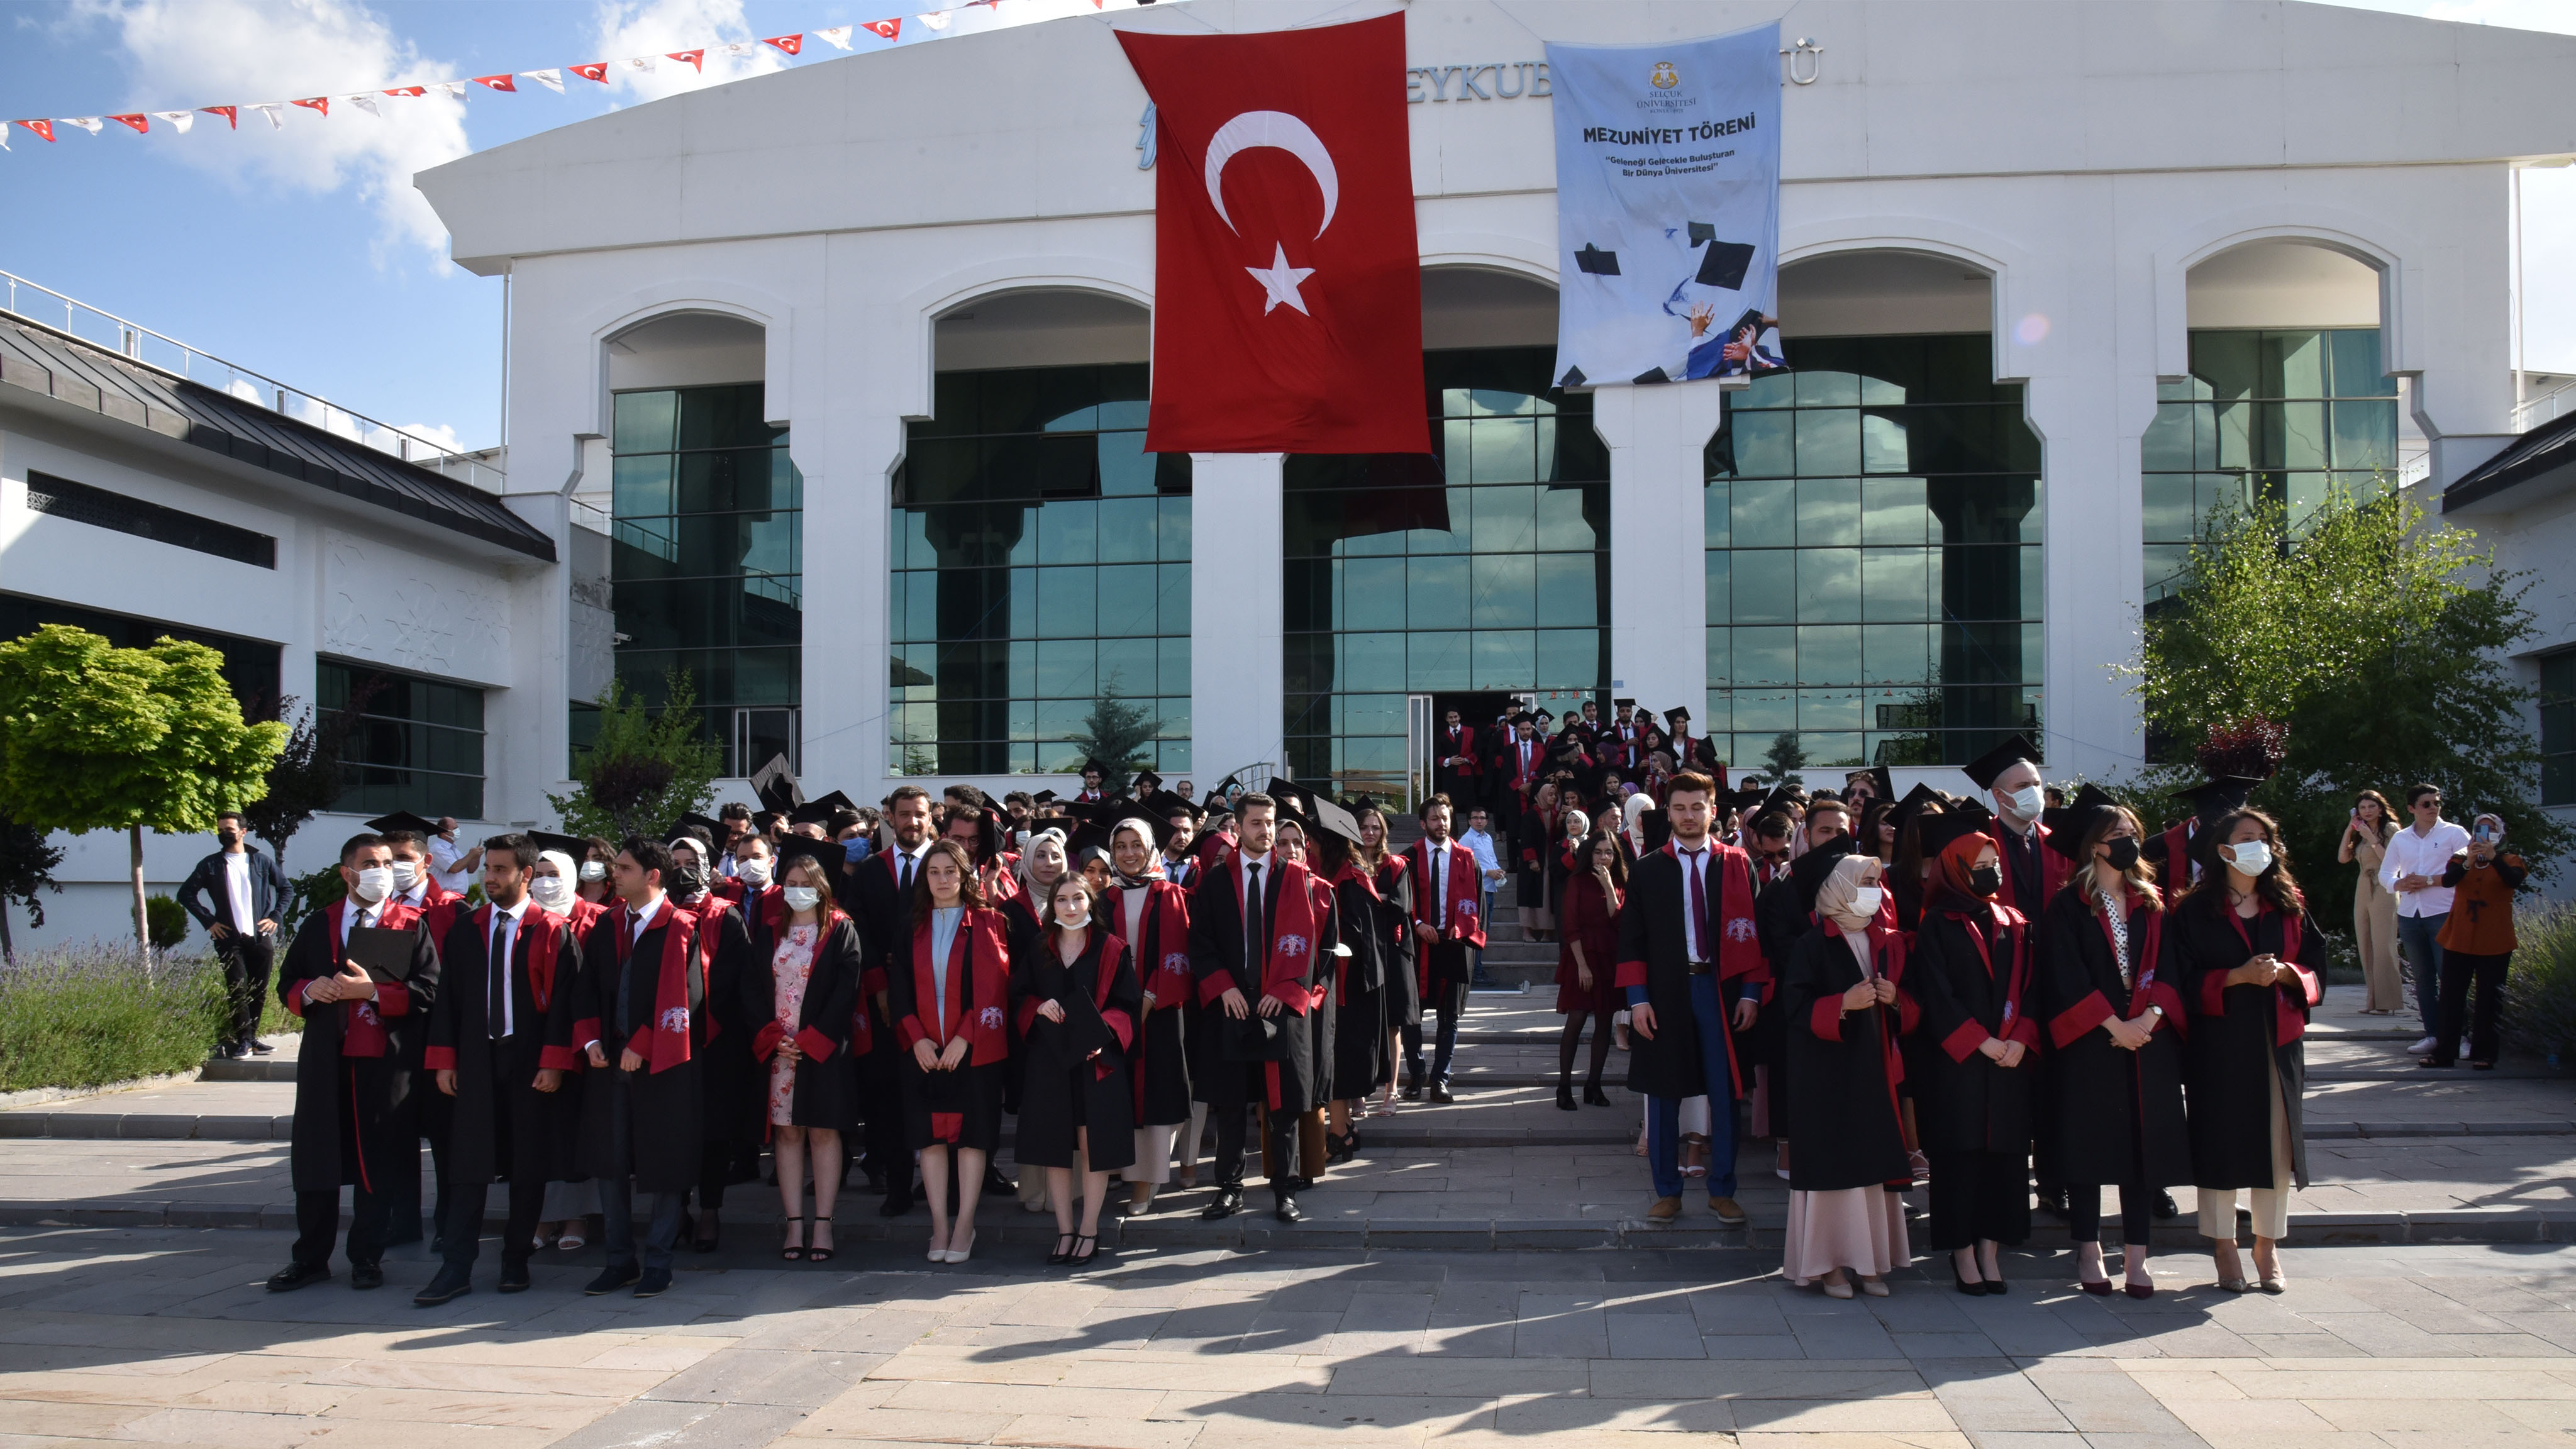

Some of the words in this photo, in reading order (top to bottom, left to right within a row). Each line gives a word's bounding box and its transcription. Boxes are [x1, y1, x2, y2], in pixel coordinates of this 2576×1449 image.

[1650, 91, 1682, 99] SELÇUK
[1636, 97, 1696, 109] ÜNİVERSİTESİ
[1584, 126, 1683, 145] MEZUNİYET
[1689, 111, 1755, 141] TÖRENİ
[1648, 157, 1687, 165] Gelecekle
[1689, 150, 1735, 162] Buluşturan
[1623, 169, 1633, 177] Bir
[1636, 169, 1663, 177] Dünya
